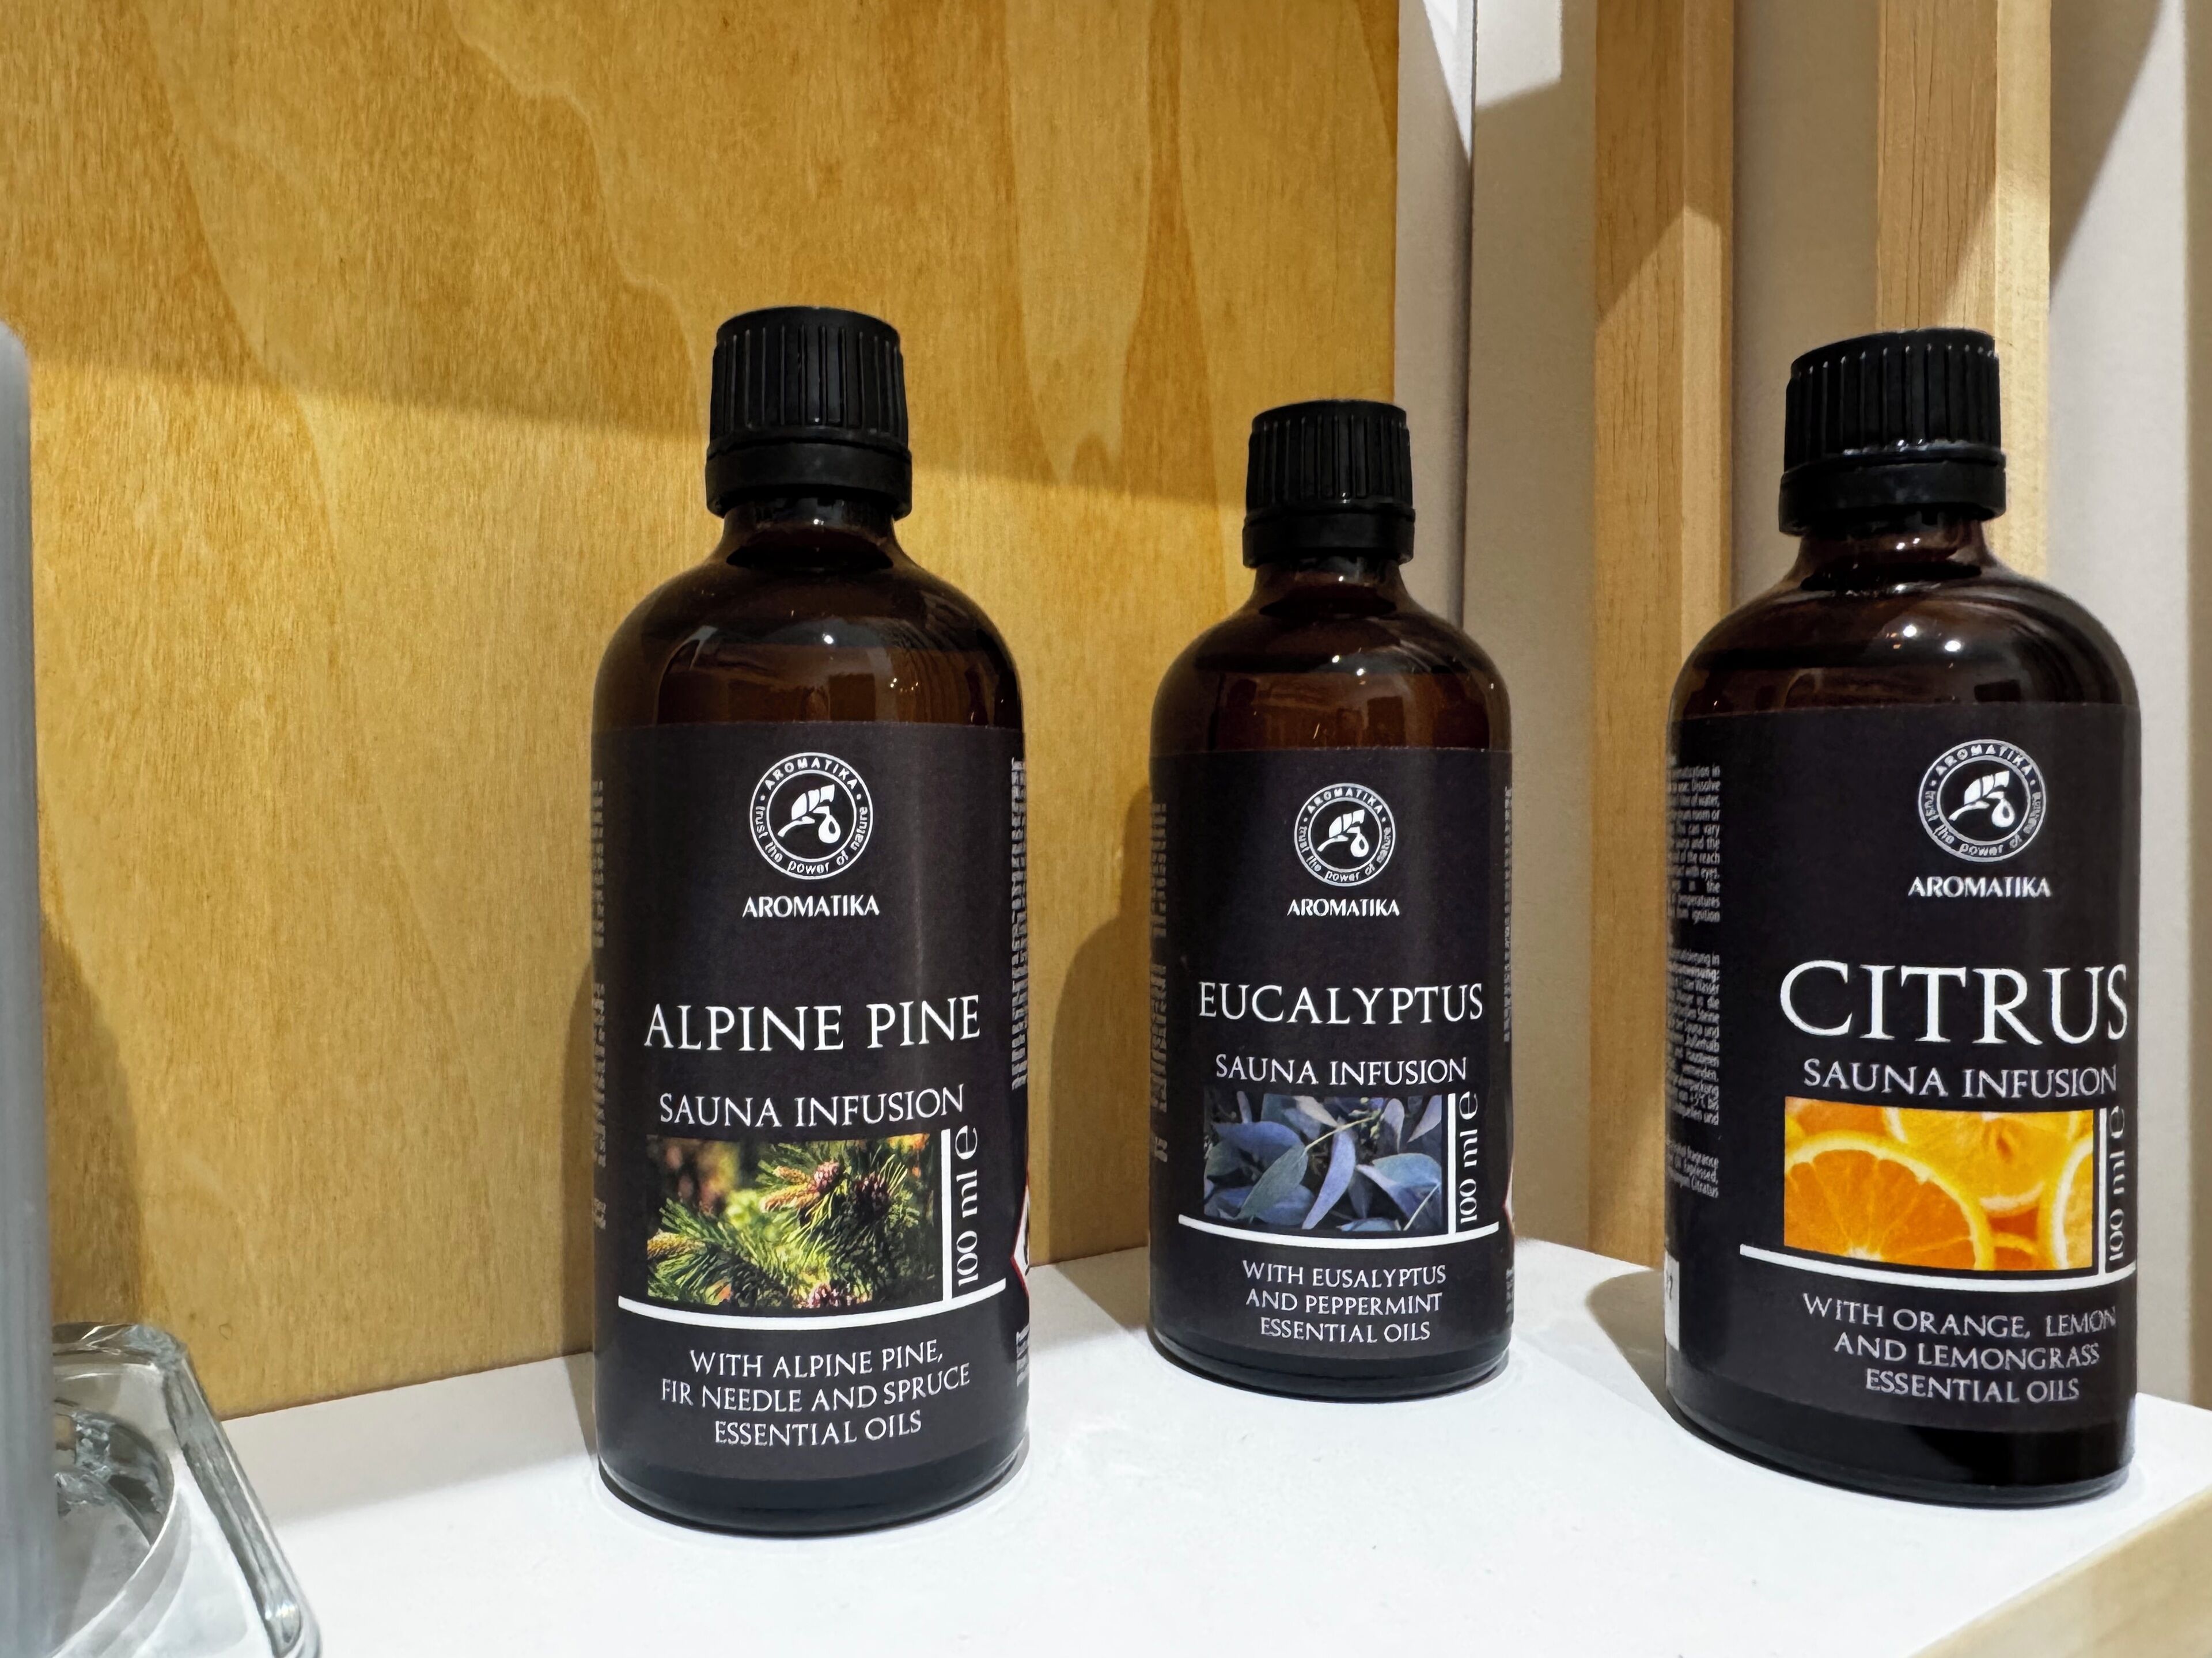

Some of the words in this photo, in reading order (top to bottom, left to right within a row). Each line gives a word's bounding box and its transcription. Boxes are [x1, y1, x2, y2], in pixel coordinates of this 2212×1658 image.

[764, 757, 858, 791] AROMATIKA
[1936, 744, 2033, 776] AROMATIKA
[1307, 787, 1382, 814] AROMATIKA
[755, 806, 769, 839] trust
[764, 841, 783, 863] the
[787, 860, 830, 874] power
[836, 849, 849, 866] of
[850, 806, 868, 851] nature
[743, 894, 880, 917] AROMATIKA
[1908, 876, 2051, 898] AROMATIKA
[1287, 898, 1400, 916] AROMATIKA
[1199, 982, 1482, 1025] EUCALYPTUS
[1781, 960, 2127, 1045] CITRUS
[644, 1004, 843, 1051] ALPINE
[866, 995, 980, 1048] PINE
[1216, 1054, 1319, 1084] SAUNA
[1330, 1057, 1466, 1085] INFUSION
[1804, 1058, 1948, 1097] SAUNA
[1962, 1065, 2116, 1098] INFUSION
[660, 1093, 782, 1127] SAUNA
[794, 1083, 965, 1127] INFUSION
[1460, 1129, 1478, 1167] ml
[2109, 1149, 2125, 1196] ml
[956, 1170, 978, 1216] ml
[1459, 1179, 1477, 1224] 100
[2109, 1208, 2124, 1261] 100
[958, 1235, 978, 1287] 100
[1243, 1260, 1303, 1285] WITH
[1313, 1265, 1446, 1288] EUSALYPTUS
[1246, 1288, 1297, 1311] AND
[1305, 1292, 1442, 1315] PEPPERMINT
[1803, 1293, 1883, 1327] WITH
[2046, 1307, 2115, 1337] LEMON
[1261, 1318, 1377, 1343] ESSENTIAL
[1384, 1322, 1430, 1342] OILS
[690, 1350, 763, 1378] WITH
[772, 1353, 872, 1379] ALPINE
[882, 1339, 942, 1374] PINE,
[1834, 1332, 1906, 1361] AND
[1918, 1343, 2099, 1370] LEMONGRASS
[662, 1378, 693, 1406] FIR
[702, 1385, 802, 1412] NEEDLE
[810, 1385, 877, 1412] AND
[884, 1363, 971, 1405] SPRUCE
[1866, 1369, 2019, 1402] ESSENTIAL
[2027, 1379, 2079, 1402] OILS
[715, 1421, 857, 1447] ESSENTIAL
[865, 1410, 922, 1440] OILS
